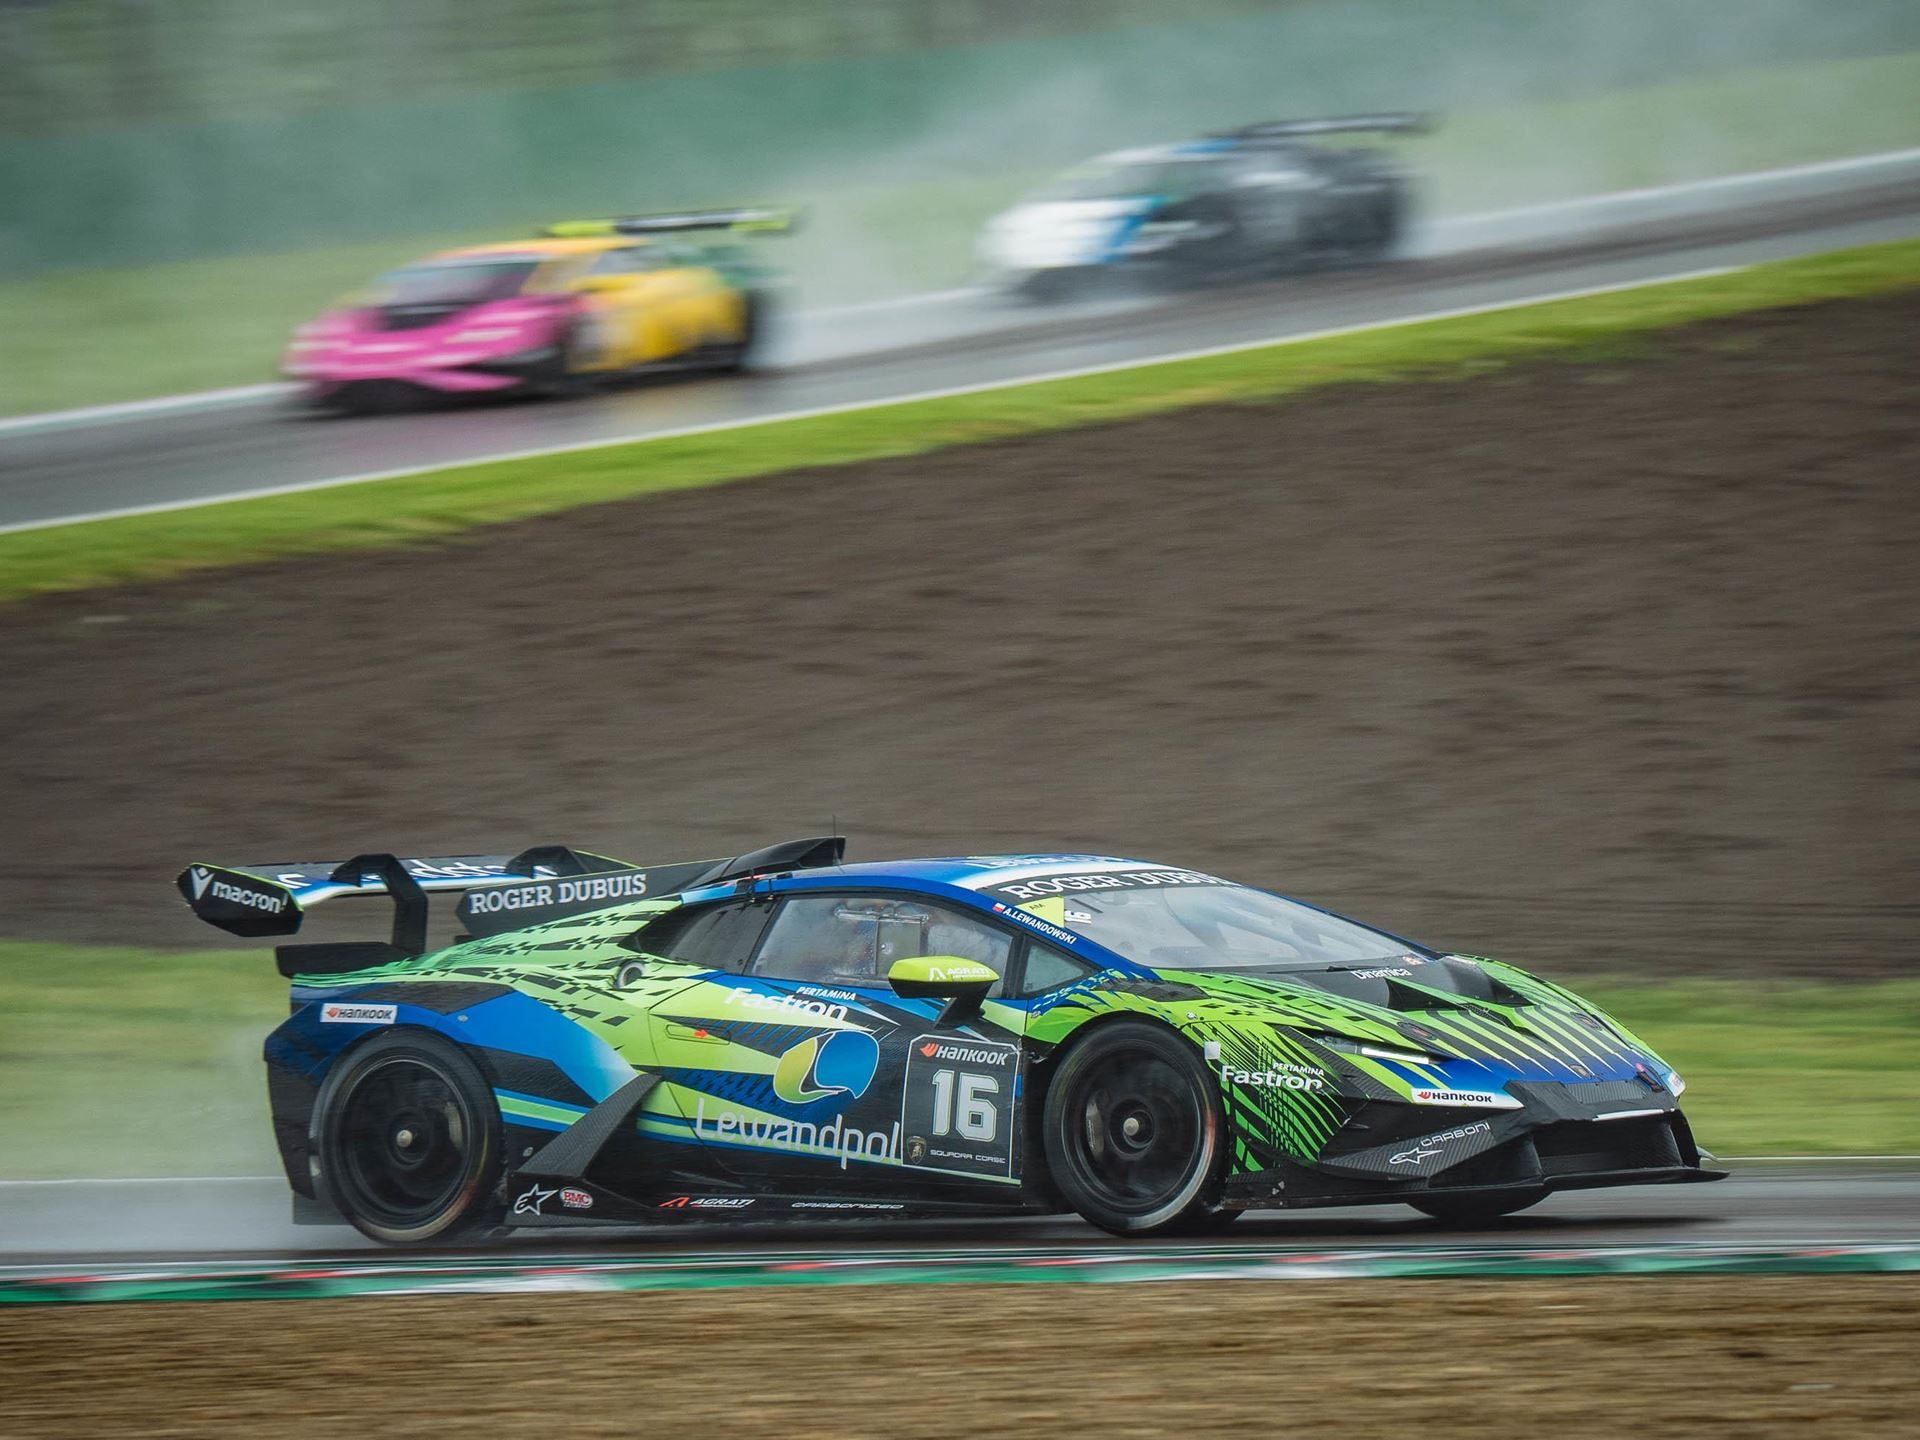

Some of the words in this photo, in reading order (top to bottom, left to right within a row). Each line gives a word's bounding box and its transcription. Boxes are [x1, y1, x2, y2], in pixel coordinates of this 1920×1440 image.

[469, 888, 554, 914] ROGER
[559, 874, 647, 904] DUBUIS
[999, 873, 1134, 898] ROGER
[1003, 907, 1077, 945] A.LEWANDOWSKI
[723, 987, 848, 1022] Fastron
[796, 986, 856, 1001] PERTAMINA
[1221, 1065, 1323, 1093] Fastron
[1273, 1062, 1325, 1076] PERTAMINA
[932, 1068, 1000, 1143] 16
[694, 1097, 901, 1170] Lewandpol
[1420, 1122, 1491, 1147] CARBONI
[930, 1149, 973, 1160] SQUADRA
[975, 1155, 1006, 1164] CORSE
[563, 1191, 590, 1205] BMC
